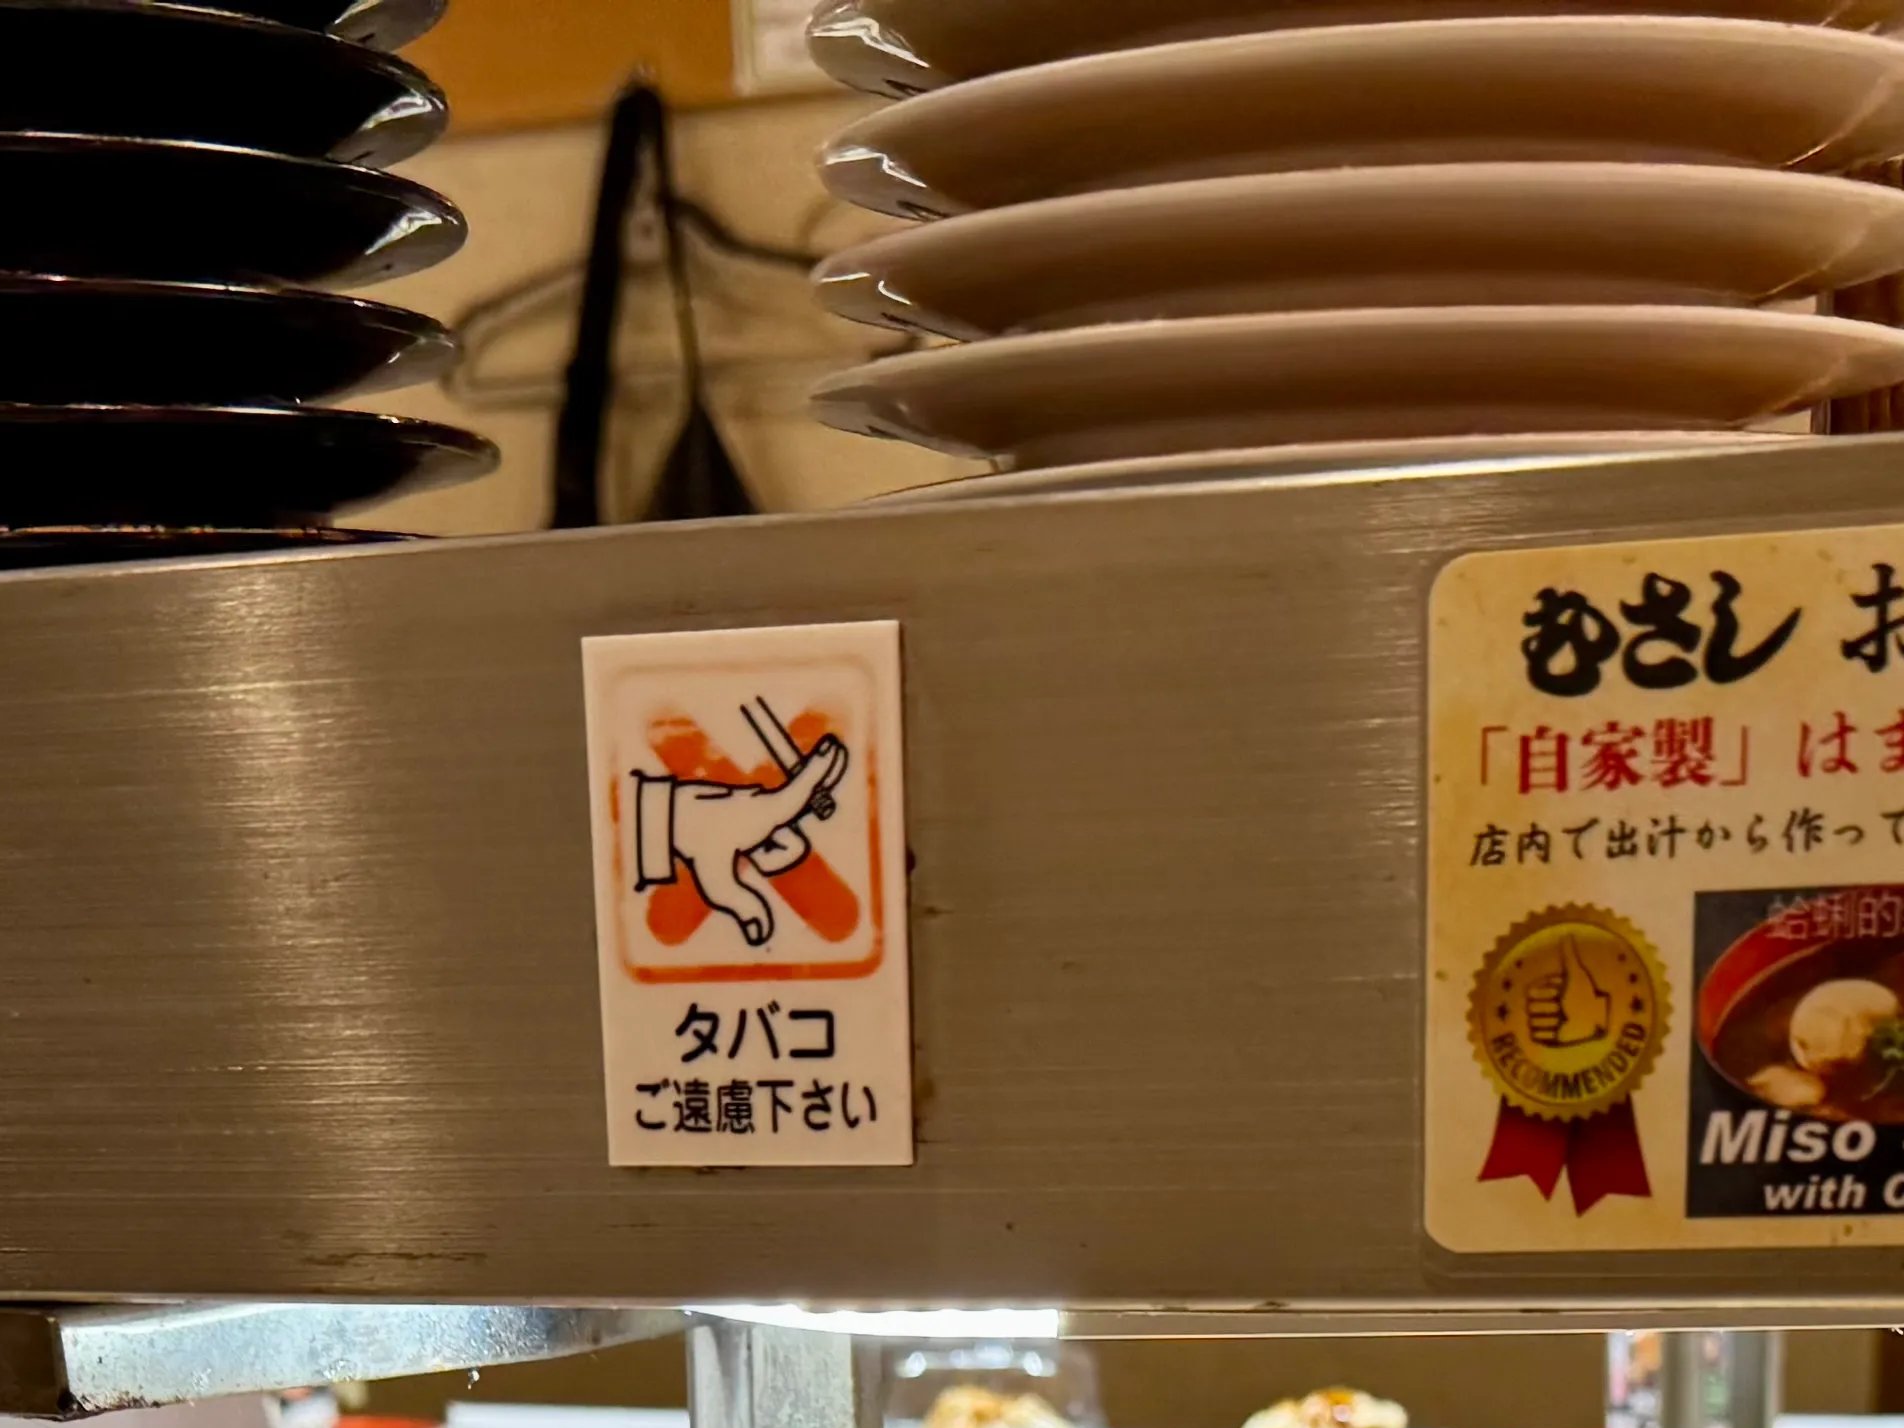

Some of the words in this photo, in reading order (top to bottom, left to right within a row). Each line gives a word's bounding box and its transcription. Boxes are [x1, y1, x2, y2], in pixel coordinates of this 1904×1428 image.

[1522, 570, 1802, 696] むさし
[675, 1001, 836, 1063] タバコ
[1493, 1021, 1648, 1104] RECOMMENDED
[635, 1078, 878, 1135] ご遠慮下さい
[1700, 1109, 1876, 1167] Miso
[1763, 1172, 1868, 1212] with
